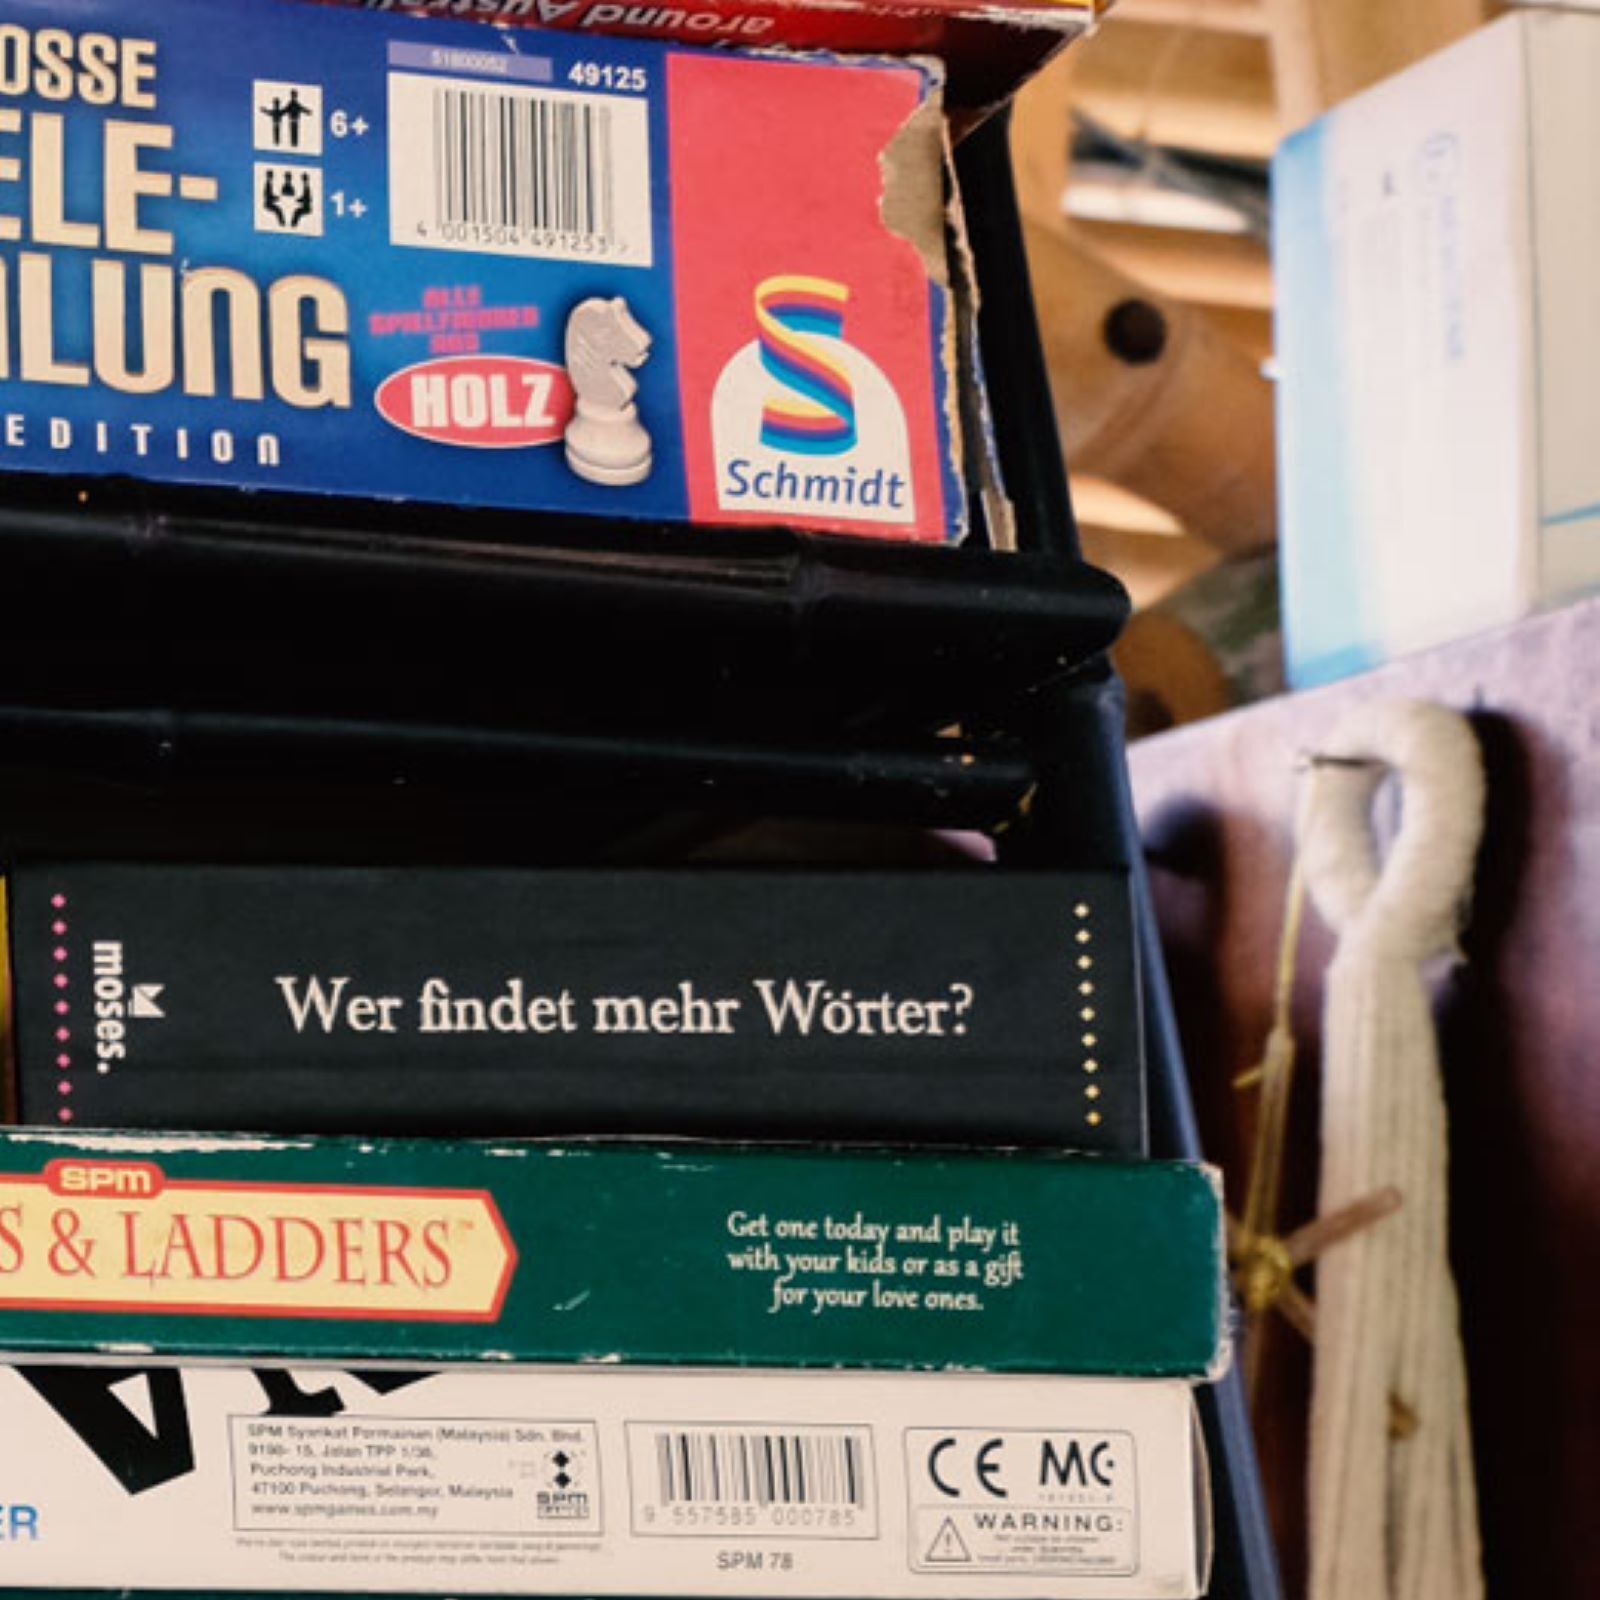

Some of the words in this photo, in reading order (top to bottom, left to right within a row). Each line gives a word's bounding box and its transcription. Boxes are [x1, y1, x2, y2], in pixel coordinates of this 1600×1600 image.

[584, 4, 775, 34] around
[568, 60, 647, 91] 49125
[330, 109, 369, 138] 6+
[330, 192, 367, 218] 1+
[410, 372, 557, 428] HOLZ
[725, 459, 906, 508] Schmidt
[92, 940, 126, 1075] moses.
[274, 974, 402, 1033] Wer
[418, 979, 578, 1034] findet
[593, 979, 740, 1035] mehr
[753, 980, 976, 1037] Wörter?
[60, 1166, 153, 1195] SPM
[48, 1207, 97, 1276] &
[120, 1208, 454, 1291] LADDERS
[727, 1210, 769, 1238] Get
[774, 1220, 819, 1240] one
[824, 1211, 889, 1244] today
[895, 1215, 941, 1243] and
[947, 1216, 998, 1253] play
[1002, 1221, 1019, 1246] it
[726, 1243, 780, 1272] with
[785, 1253, 841, 1282] your
[846, 1244, 897, 1275] kids
[902, 1256, 929, 1276] or
[933, 1258, 959, 1277] as
[965, 1259, 979, 1277] a
[984, 1251, 1024, 1287] gift
[768, 1276, 808, 1314] for
[812, 1288, 868, 1315] your
[872, 1279, 919, 1309] love
[924, 1289, 984, 1311] ones.
[251, 1462, 317, 1479] Puchong
[321, 1463, 391, 1477] Industrial
[928, 1437, 1008, 1498] CE
[448, 1485, 514, 1500] Malaysia
[973, 1512, 1124, 1532] WARNING:
[716, 1551, 763, 1570] SPM
[768, 1552, 794, 1570] 78
